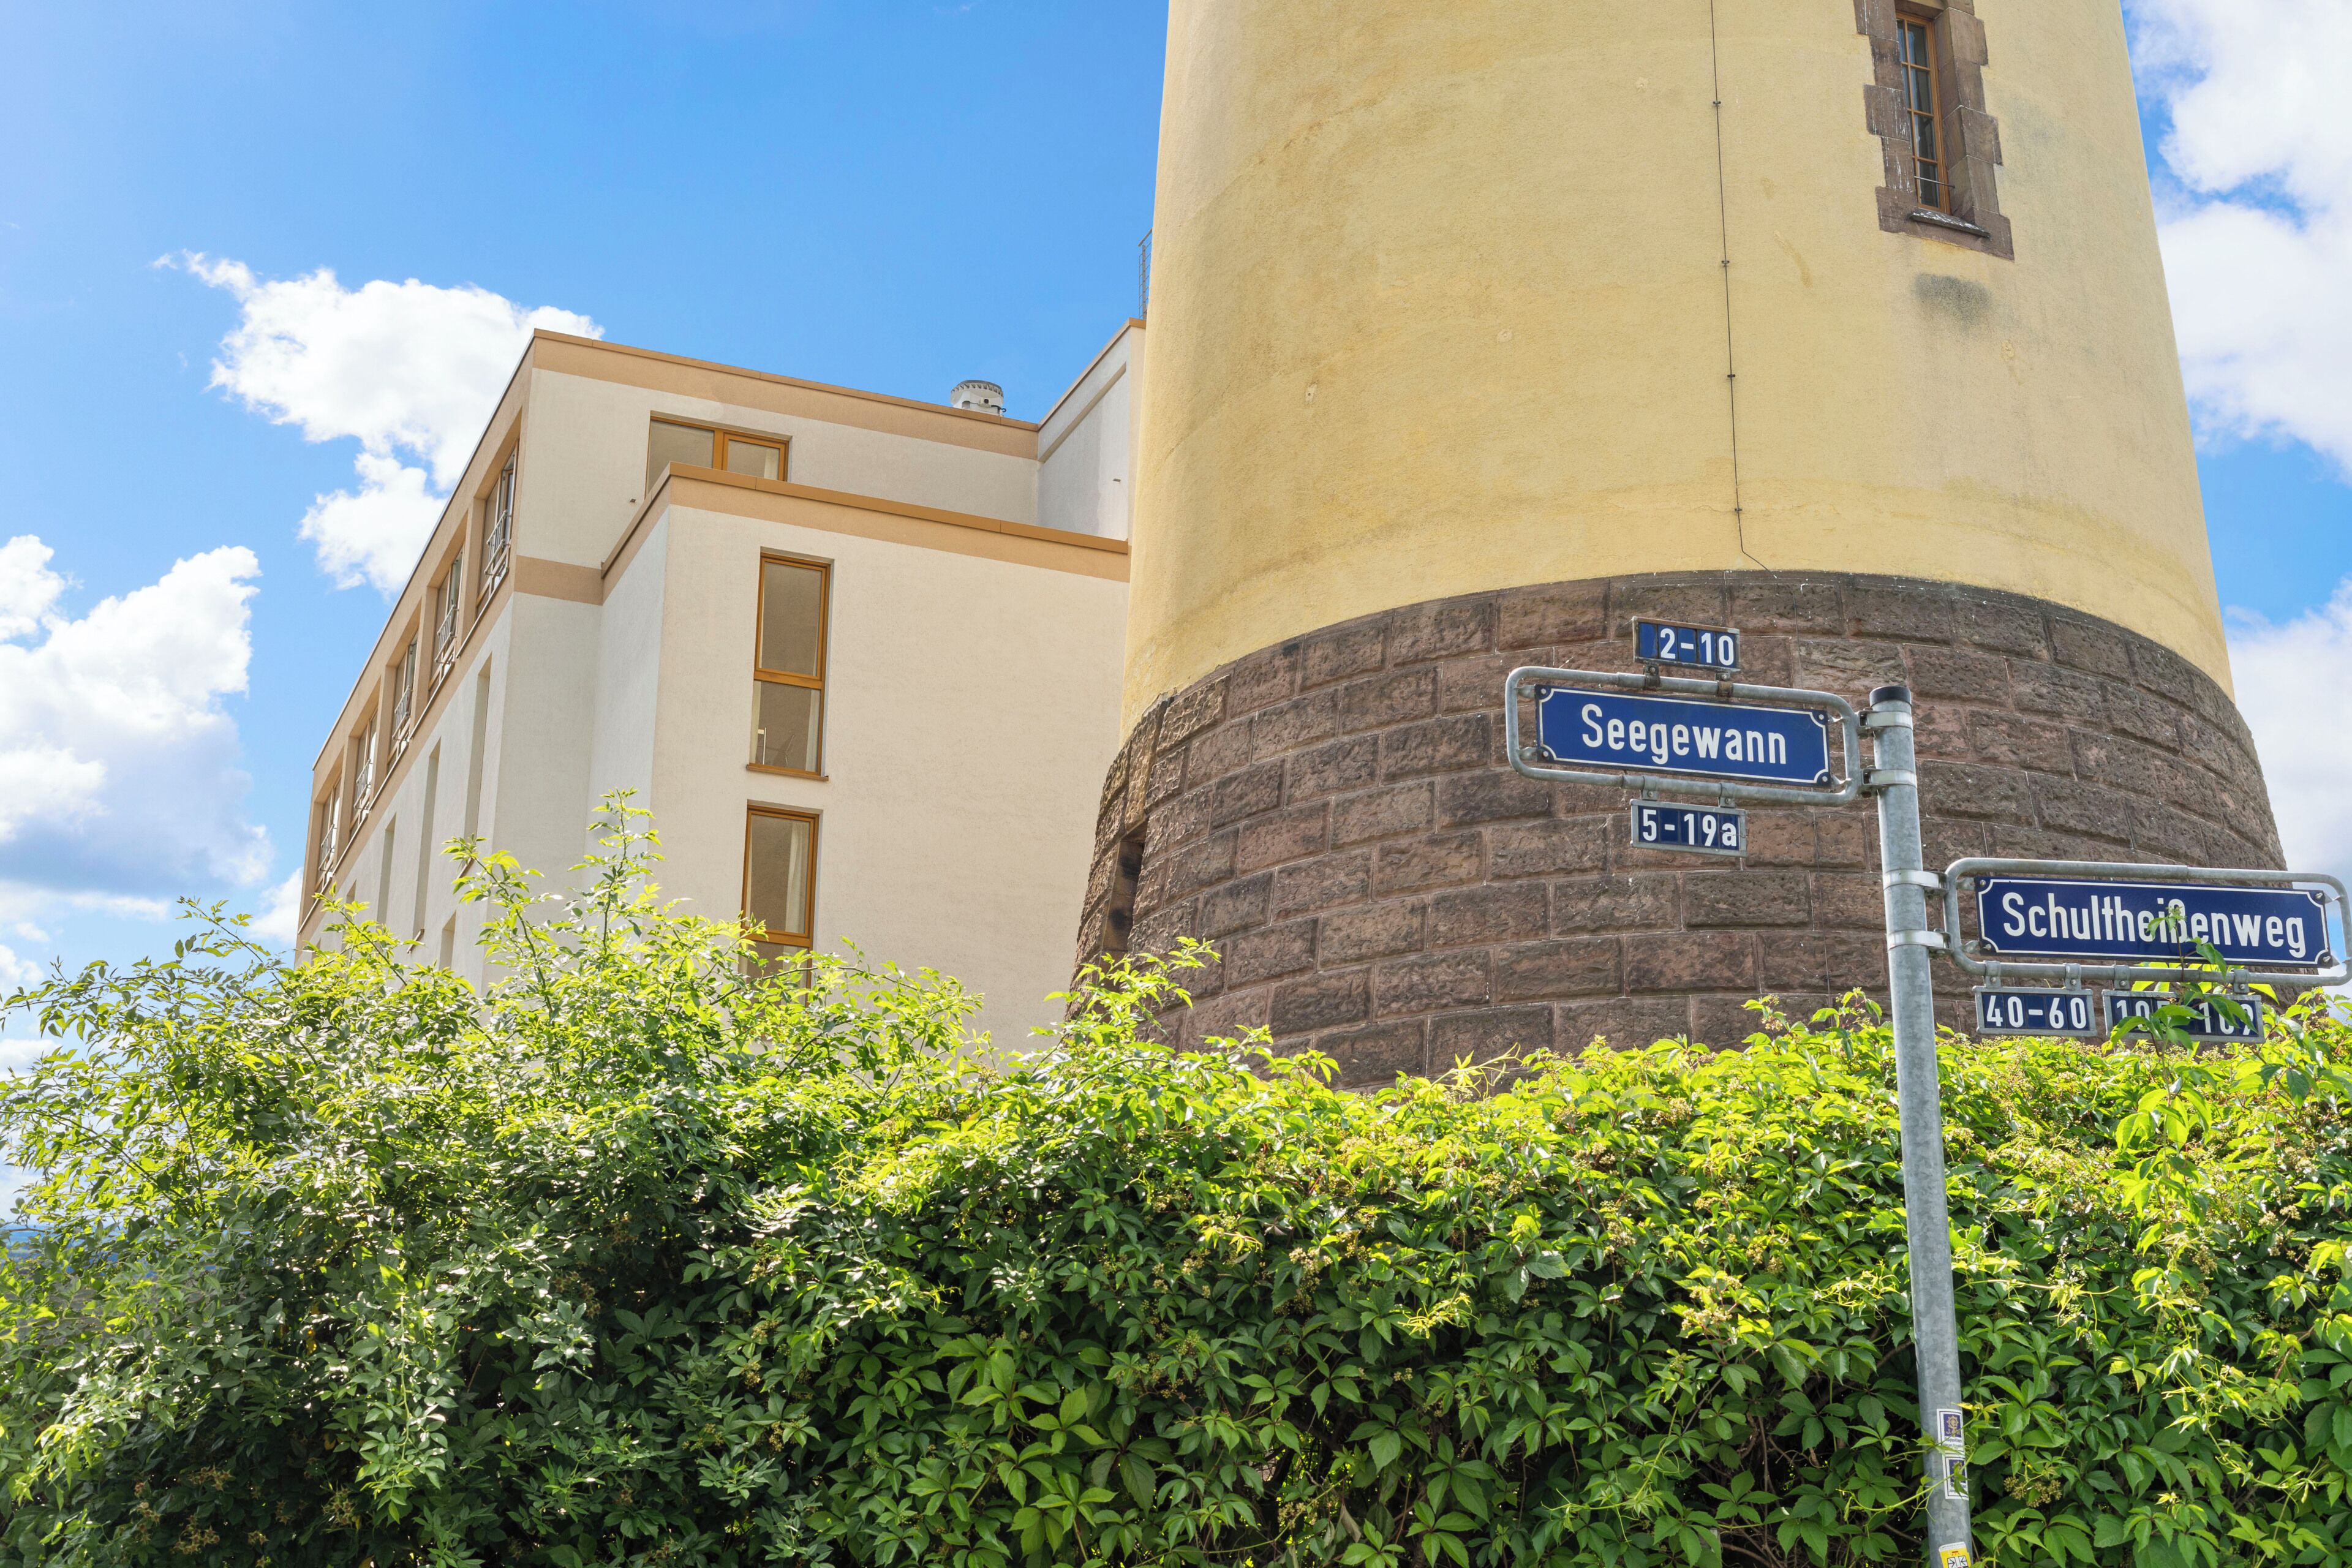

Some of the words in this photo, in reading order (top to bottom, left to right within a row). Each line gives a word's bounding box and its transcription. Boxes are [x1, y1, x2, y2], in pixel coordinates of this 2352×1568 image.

[1659, 628, 1735, 666] 2-10
[1581, 703, 1787, 765] Seegewann
[1642, 809, 1738, 847] 5-19a
[2002, 892, 2306, 959] Schultheißenweg
[1986, 995, 2087, 1030] 40-60
